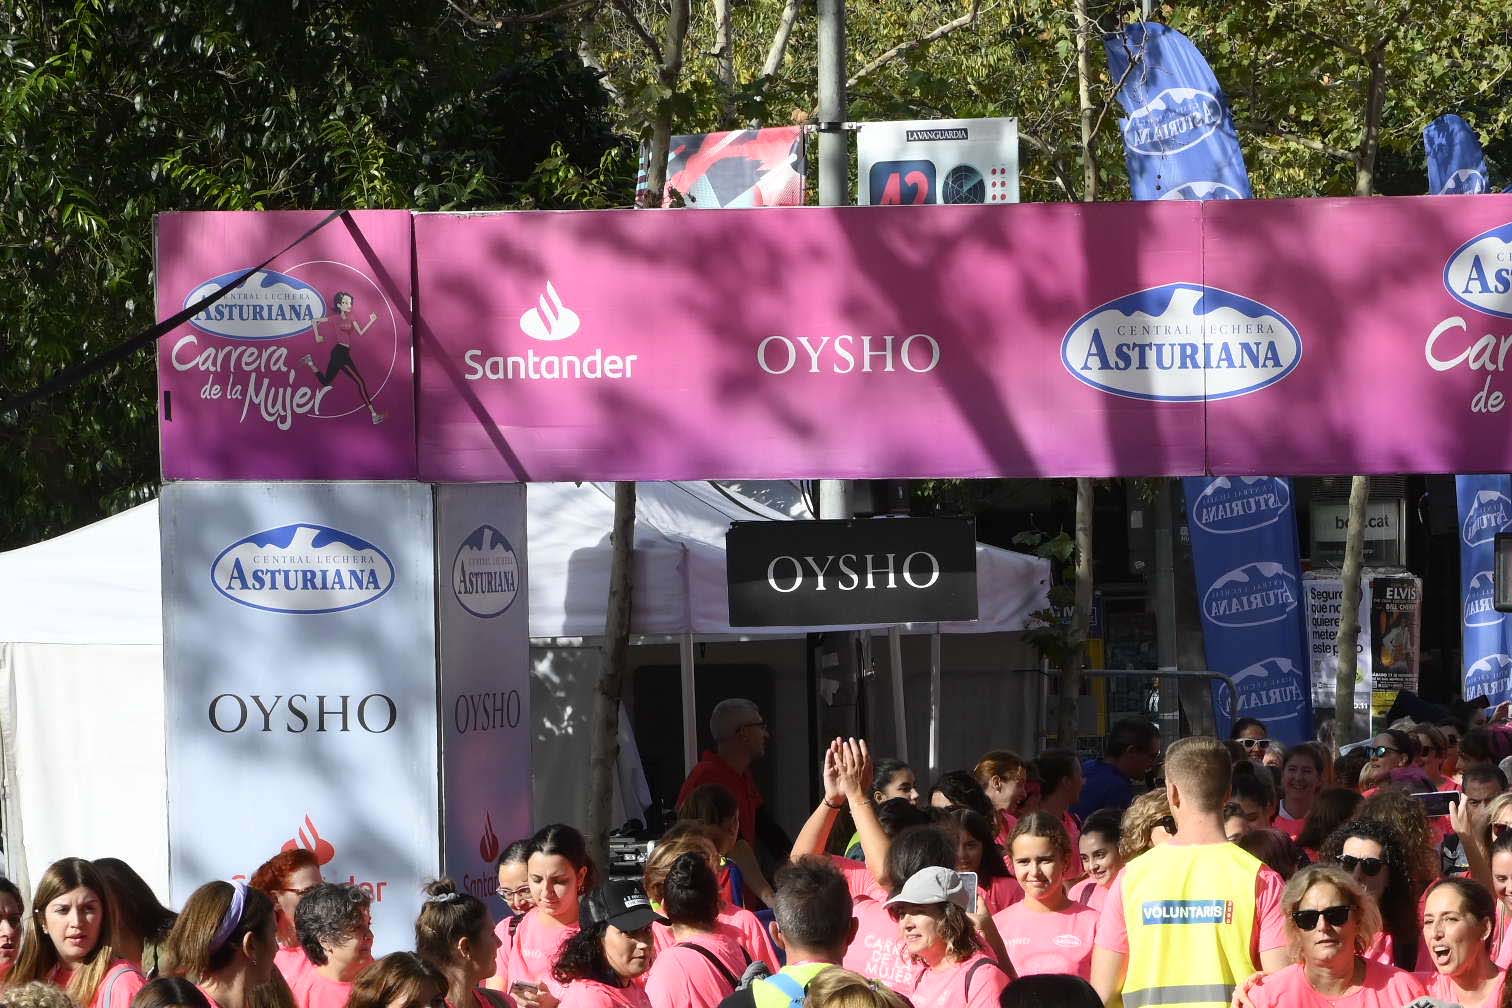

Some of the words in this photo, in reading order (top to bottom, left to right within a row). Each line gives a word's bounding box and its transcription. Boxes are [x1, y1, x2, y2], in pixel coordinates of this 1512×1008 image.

[194, 295, 315, 322] ASTURIANA
[220, 292, 260, 300] ENTRAL
[263, 292, 311, 300] LECHERA
[1117, 324, 1192, 337] CENTRAL
[171, 335, 288, 372] Carrera
[464, 347, 637, 381] Santander
[757, 334, 940, 375] OYSHO
[1080, 327, 1283, 372] ASTURIANA
[200, 374, 221, 400] de
[226, 374, 242, 399] la
[239, 368, 333, 431] Mujer
[1471, 374, 1505, 413] de
[1335, 514, 1390, 530] b.cat
[225, 557, 382, 591] ASTURIANA
[253, 555, 311, 565] CENTRAL
[315, 555, 375, 564] LECHERA
[457, 559, 515, 595] ASTURIANA
[768, 551, 940, 593] OYSHO
[1386, 587, 1417, 600] ELVIS
[209, 693, 397, 734] OYSHO
[454, 689, 521, 734] OYSHO
[1143, 905, 1223, 920] VOLUNTARIS
[866, 964, 912, 984] MUJER
